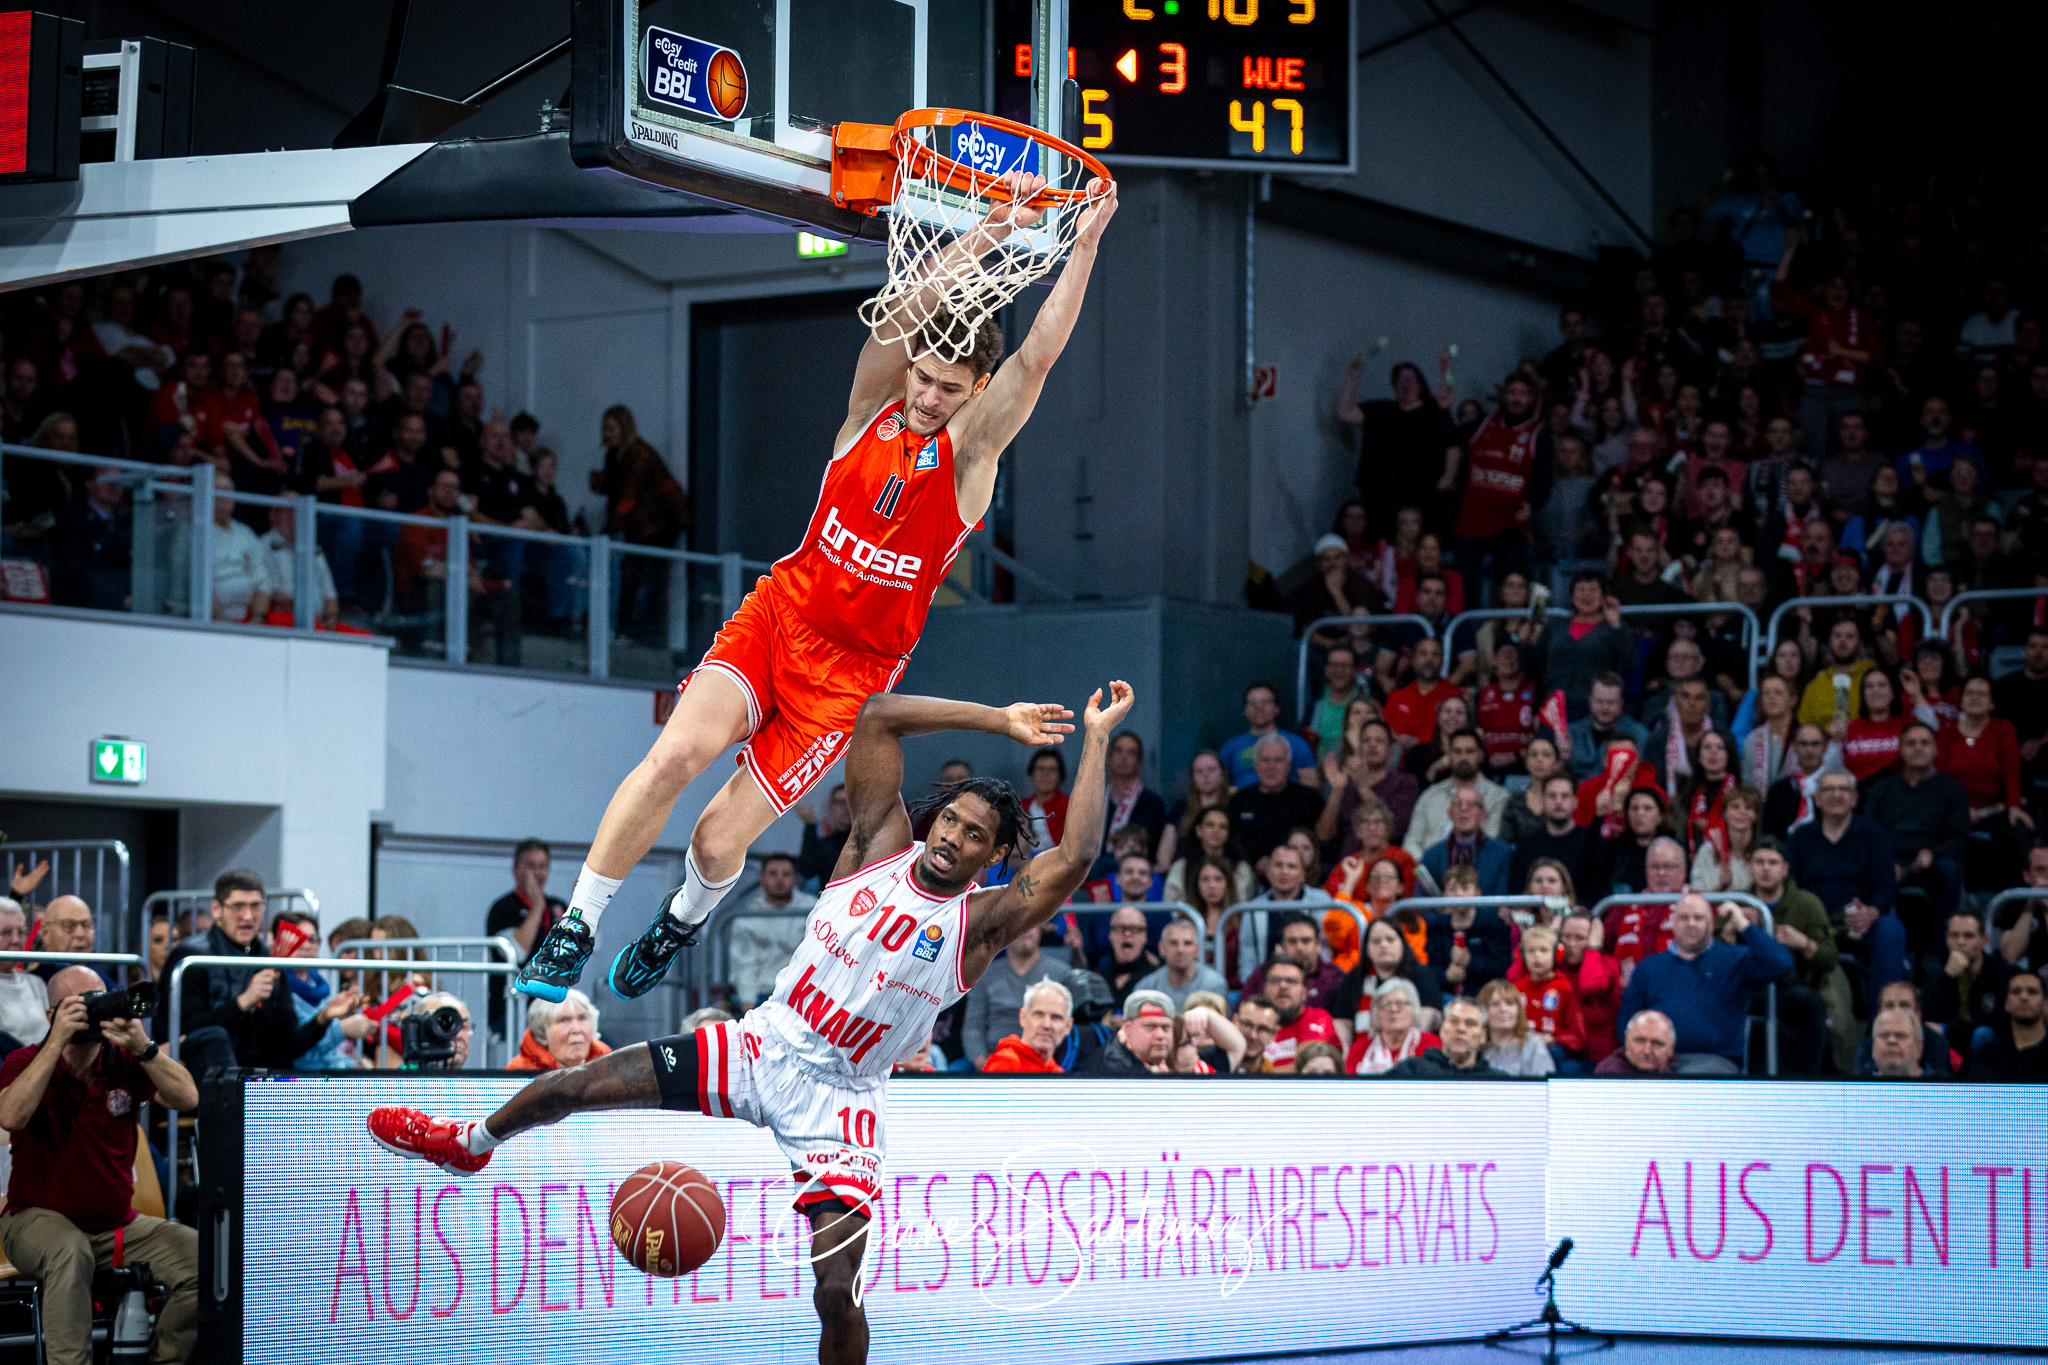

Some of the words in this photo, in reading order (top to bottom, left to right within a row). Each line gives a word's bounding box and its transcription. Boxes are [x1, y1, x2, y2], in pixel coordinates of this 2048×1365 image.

[653, 66, 697, 104] BBL
[668, 53, 698, 74] Credit
[1159, 42, 1188, 94] 3
[1242, 55, 1306, 91] WUE
[631, 121, 679, 150] SPALDING
[1228, 98, 1305, 155] 47
[872, 473, 905, 519] 11
[817, 539, 842, 568] Technik
[843, 559, 858, 576] für
[856, 571, 914, 592] Automobile
[821, 506, 922, 579] brose
[776, 756, 806, 784] KOLLEGEN
[812, 918, 860, 970] s.Oliver
[866, 904, 918, 953] 10
[914, 947, 934, 961] BBL
[786, 963, 893, 1065] KNAUF
[885, 979, 942, 1007] SPRINTIS
[837, 1105, 877, 1149] 10
[331, 1184, 464, 1323] AUS
[492, 1182, 615, 1314] DEN
[972, 1151, 1498, 1289] BIOSPHÄRENRESERVATS
[1630, 1160, 1774, 1263] AUS
[1804, 1161, 1949, 1267] DEN
[1972, 1164, 2048, 1269] TI
